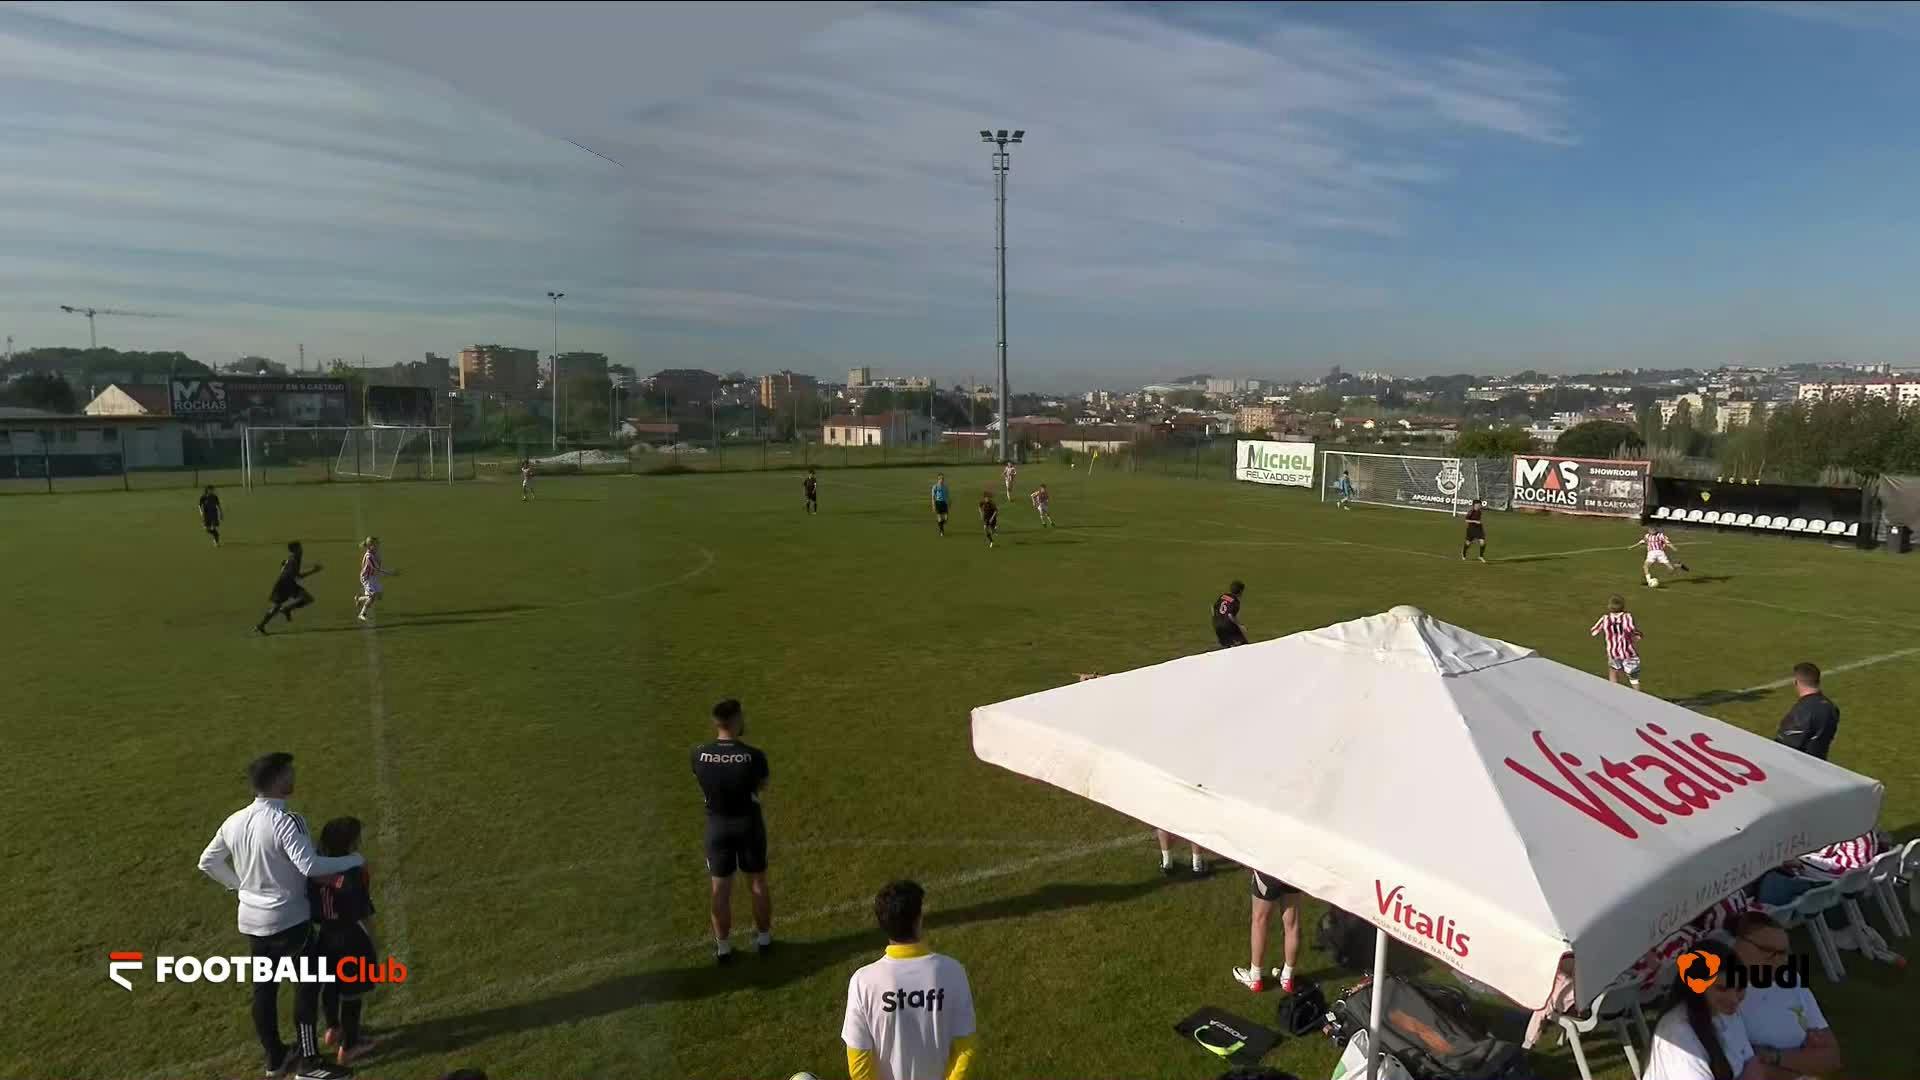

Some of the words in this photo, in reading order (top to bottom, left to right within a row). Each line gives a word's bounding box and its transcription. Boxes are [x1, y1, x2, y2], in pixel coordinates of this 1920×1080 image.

[174, 400, 227, 410] ROCHAS
[1589, 467, 1638, 477] SHOWROOM
[1514, 486, 1578, 505] ROCHAS
[1585, 499, 1595, 507] EM
[1219, 600, 1228, 615] 6
[699, 752, 752, 763] macron
[1503, 722, 1767, 840] Vitalis
[1375, 879, 1470, 957] Vitalis
[881, 988, 945, 1012] staff
